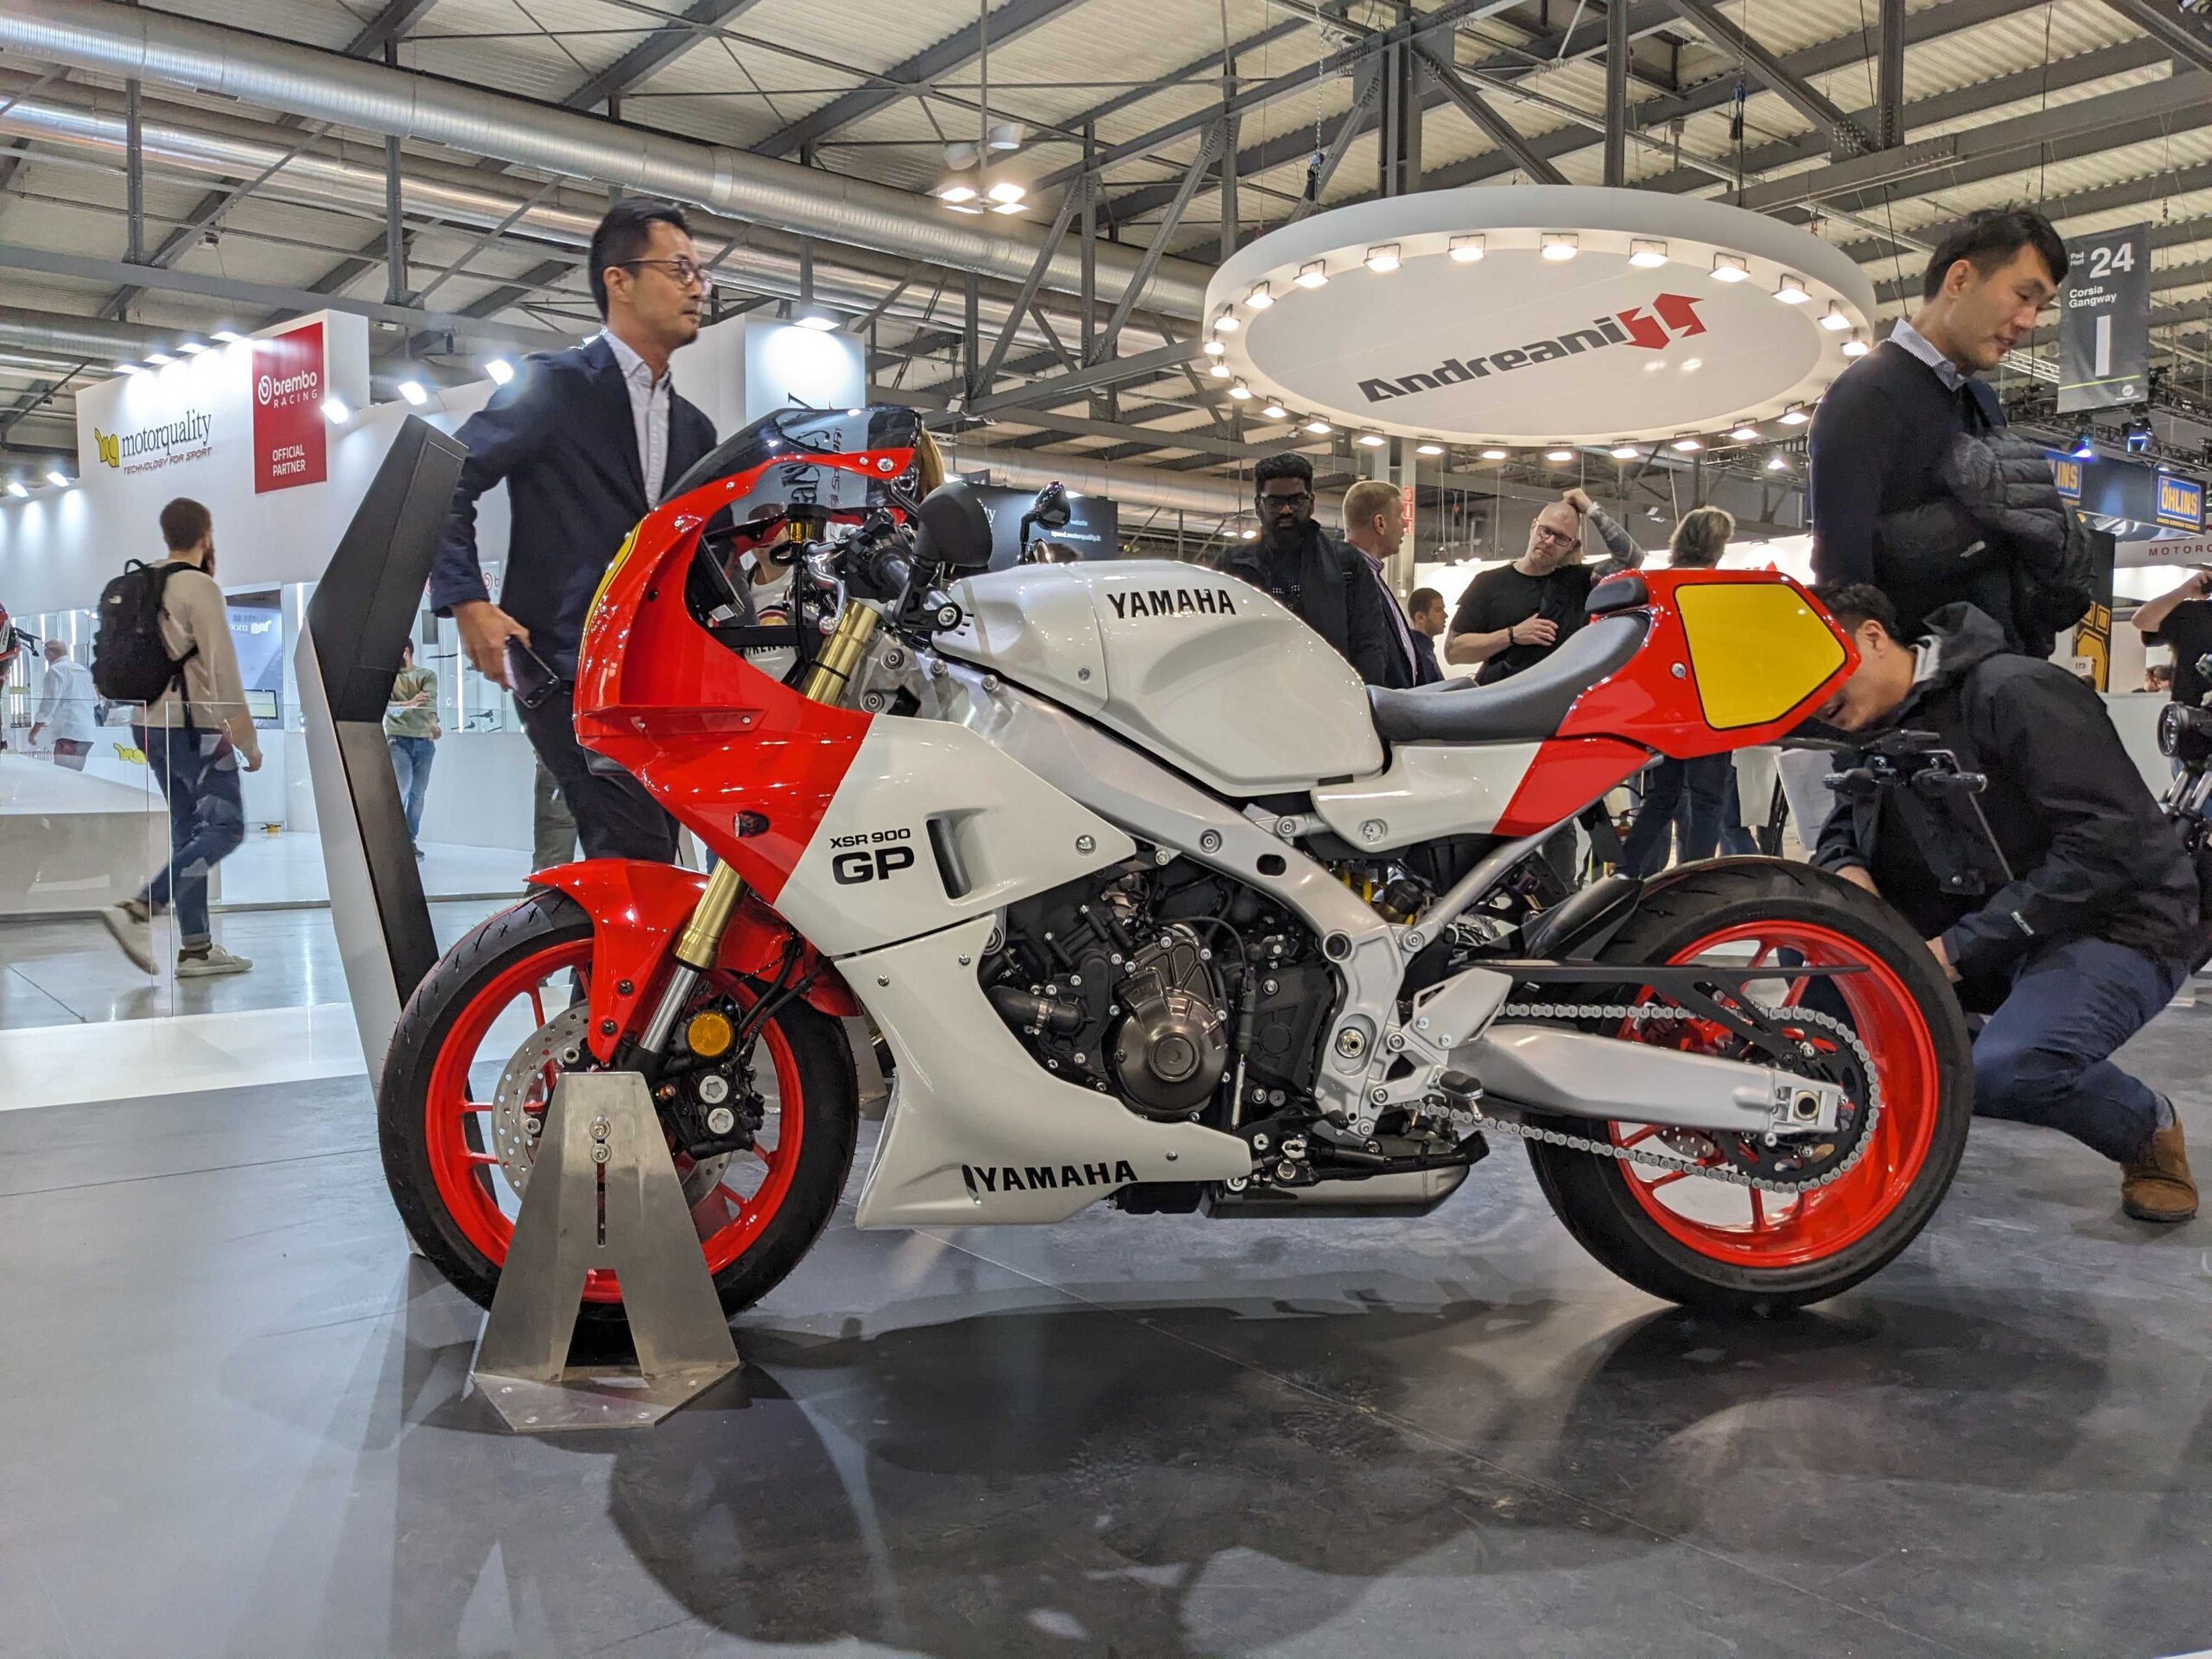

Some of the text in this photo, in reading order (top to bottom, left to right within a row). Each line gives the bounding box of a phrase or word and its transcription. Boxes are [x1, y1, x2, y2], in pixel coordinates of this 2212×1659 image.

[2089, 242, 2135, 279] 24
[2069, 285, 2103, 299] Corsia
[2069, 293, 2117, 308] Gangway
[1357, 315, 1628, 404] Andreani
[273, 370, 317, 397] brembo
[274, 389, 317, 408] RACING
[122, 408, 212, 458] motorquality
[123, 446, 213, 476] TECHNOLOGY FOR SPORT
[272, 444, 305, 461] OFFICIAL
[272, 460, 306, 477] PARTNER
[2160, 479, 2199, 517] ÖHLINS
[1106, 588, 1236, 620] YAMAHA
[830, 828, 911, 849] XSR 900
[832, 845, 915, 886] GP
[973, 1160, 1139, 1192] YAMAHA
